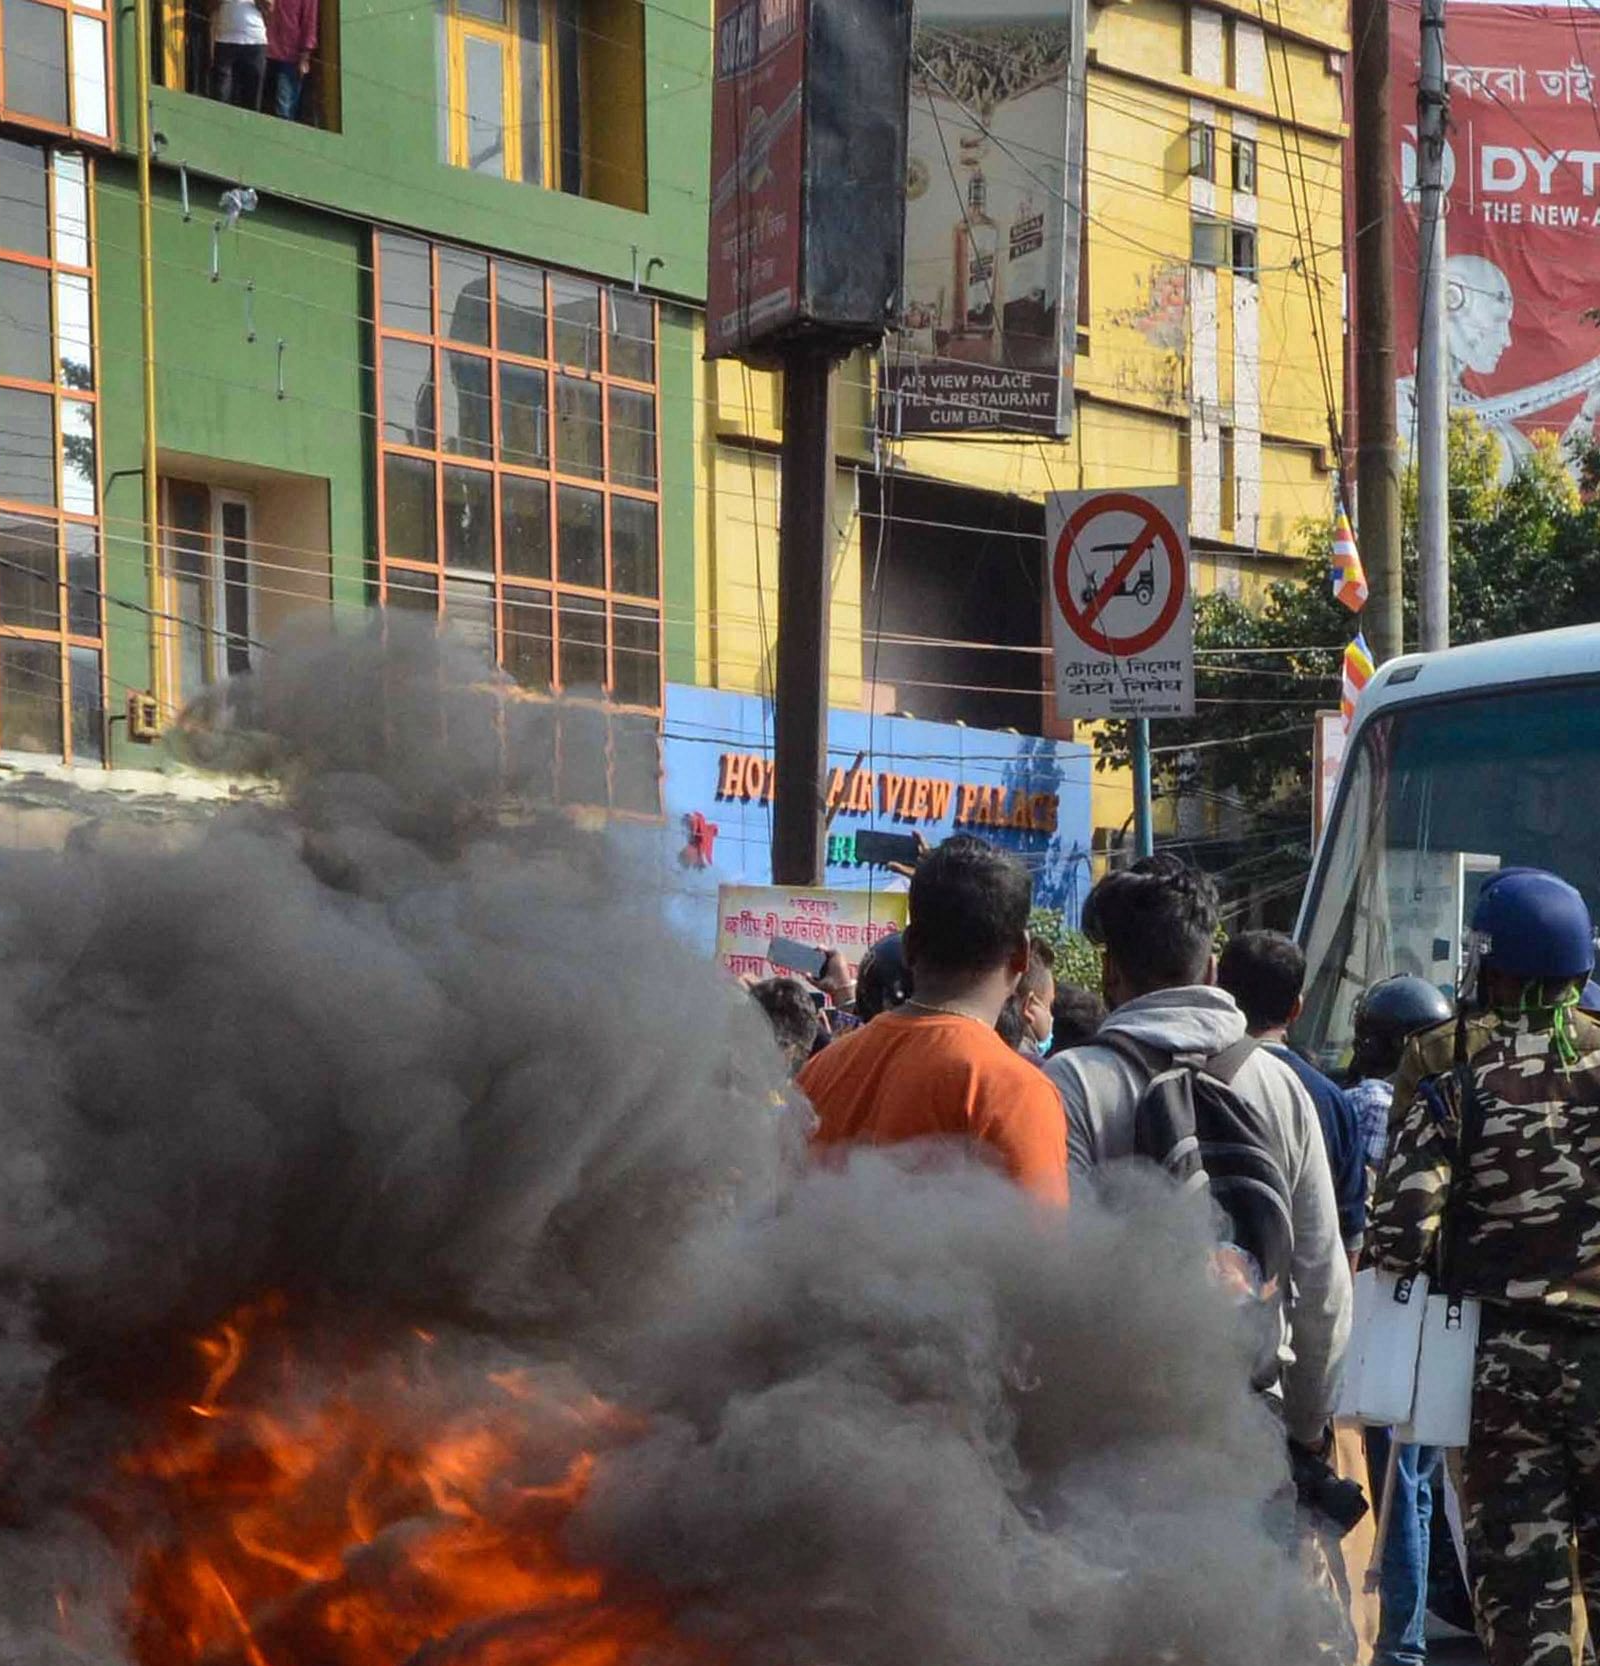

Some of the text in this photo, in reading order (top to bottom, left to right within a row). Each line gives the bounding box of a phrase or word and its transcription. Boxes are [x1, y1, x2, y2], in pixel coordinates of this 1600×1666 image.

[1482, 202, 1522, 224] THE
[931, 376, 969, 388] VIEW
[972, 375, 1032, 389] PALACE
[930, 410, 1000, 424] CUM BAR
[879, 773, 955, 822] VIEW
[954, 783, 1060, 834] PALACE
